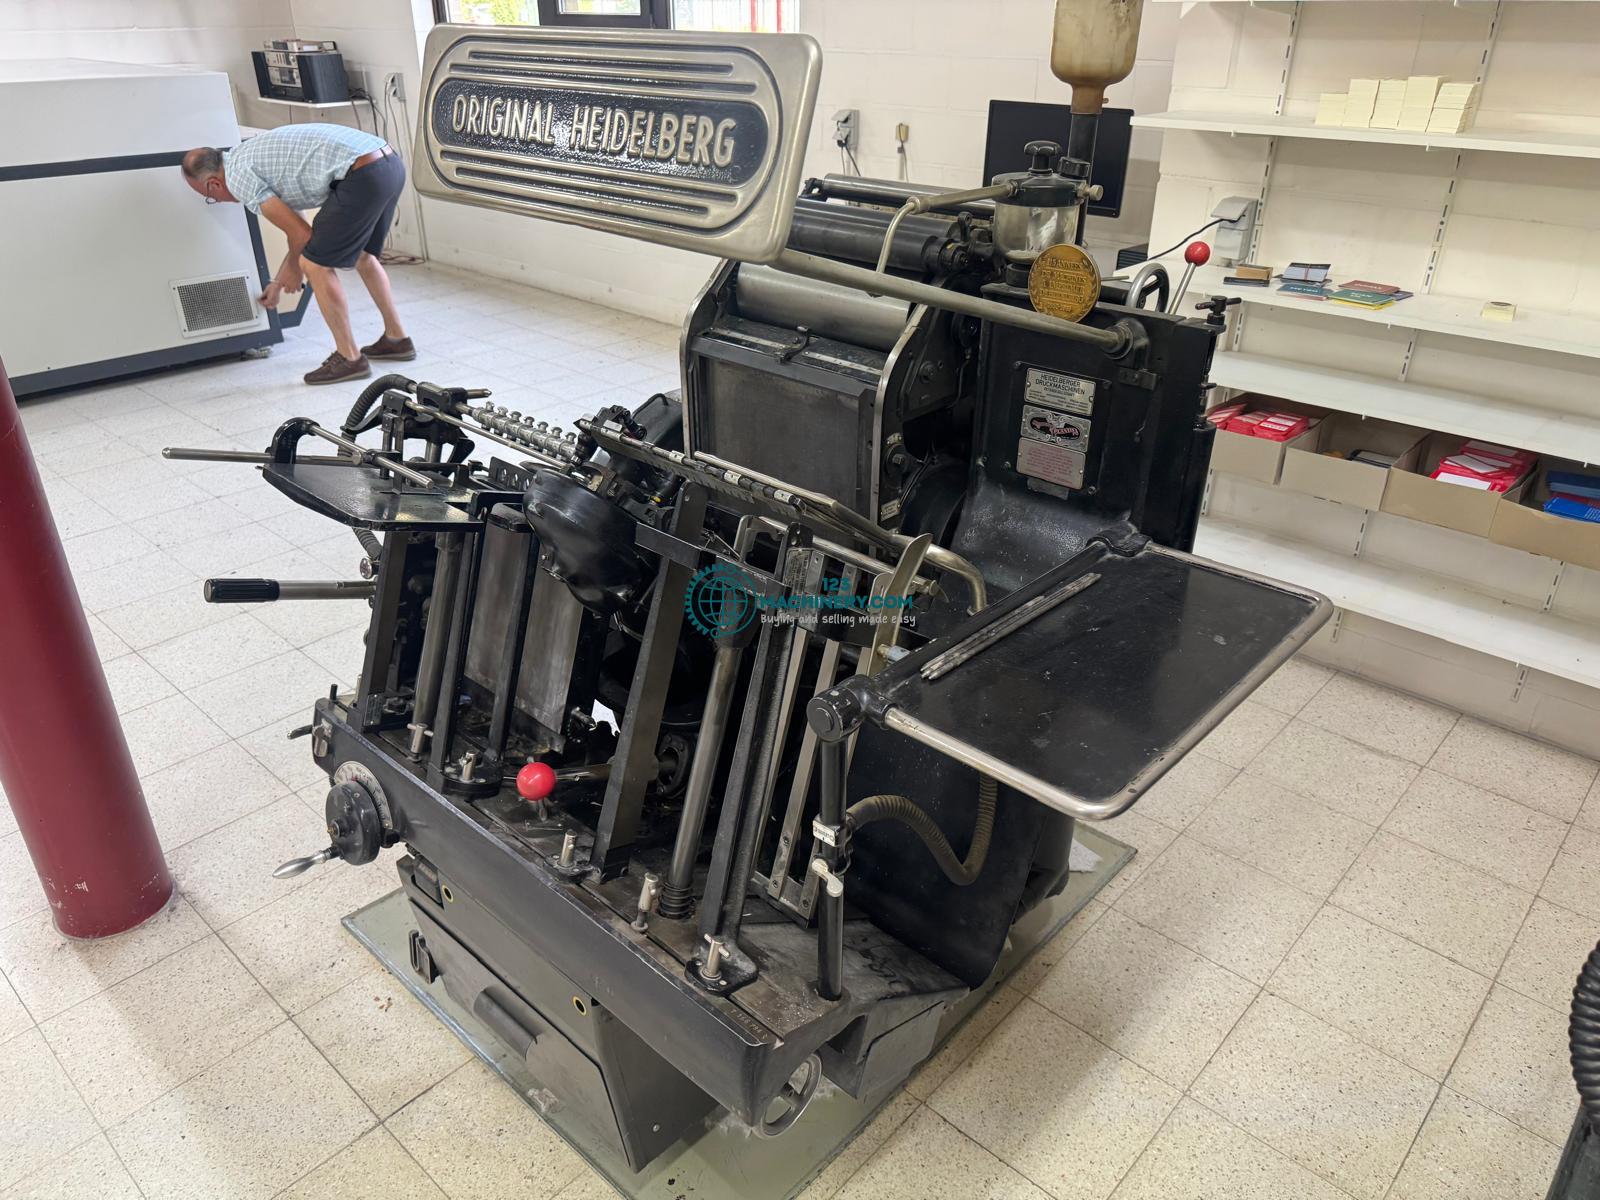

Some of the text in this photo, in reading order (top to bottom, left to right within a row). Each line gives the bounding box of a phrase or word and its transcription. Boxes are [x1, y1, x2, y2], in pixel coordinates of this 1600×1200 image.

[452, 94, 737, 168] ORIGINAL HEIDELBERG
[1035, 379, 1086, 395] DRUCKMASCHINEN
[1040, 373, 1081, 387] HEIDELBERGER
